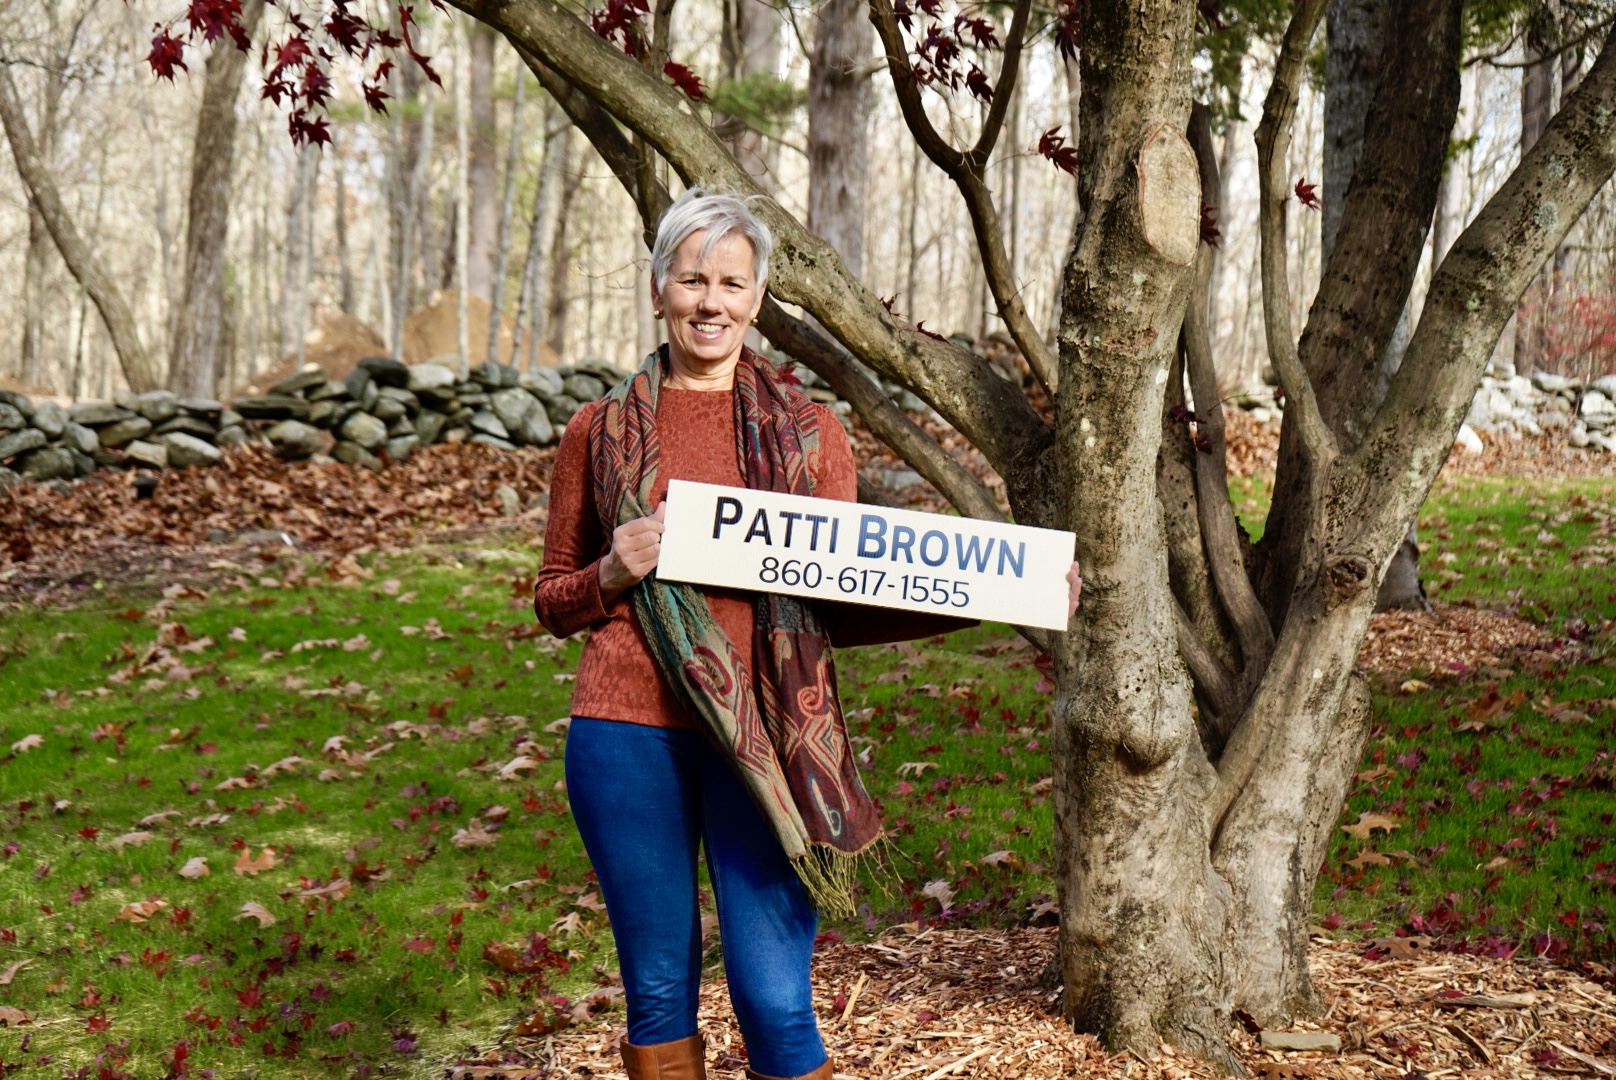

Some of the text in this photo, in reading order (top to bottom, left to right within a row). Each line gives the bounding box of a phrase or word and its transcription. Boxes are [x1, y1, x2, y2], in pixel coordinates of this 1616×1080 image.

[712, 496, 1026, 578] PATTI BROWN
[758, 556, 970, 608] 860-617-1555
